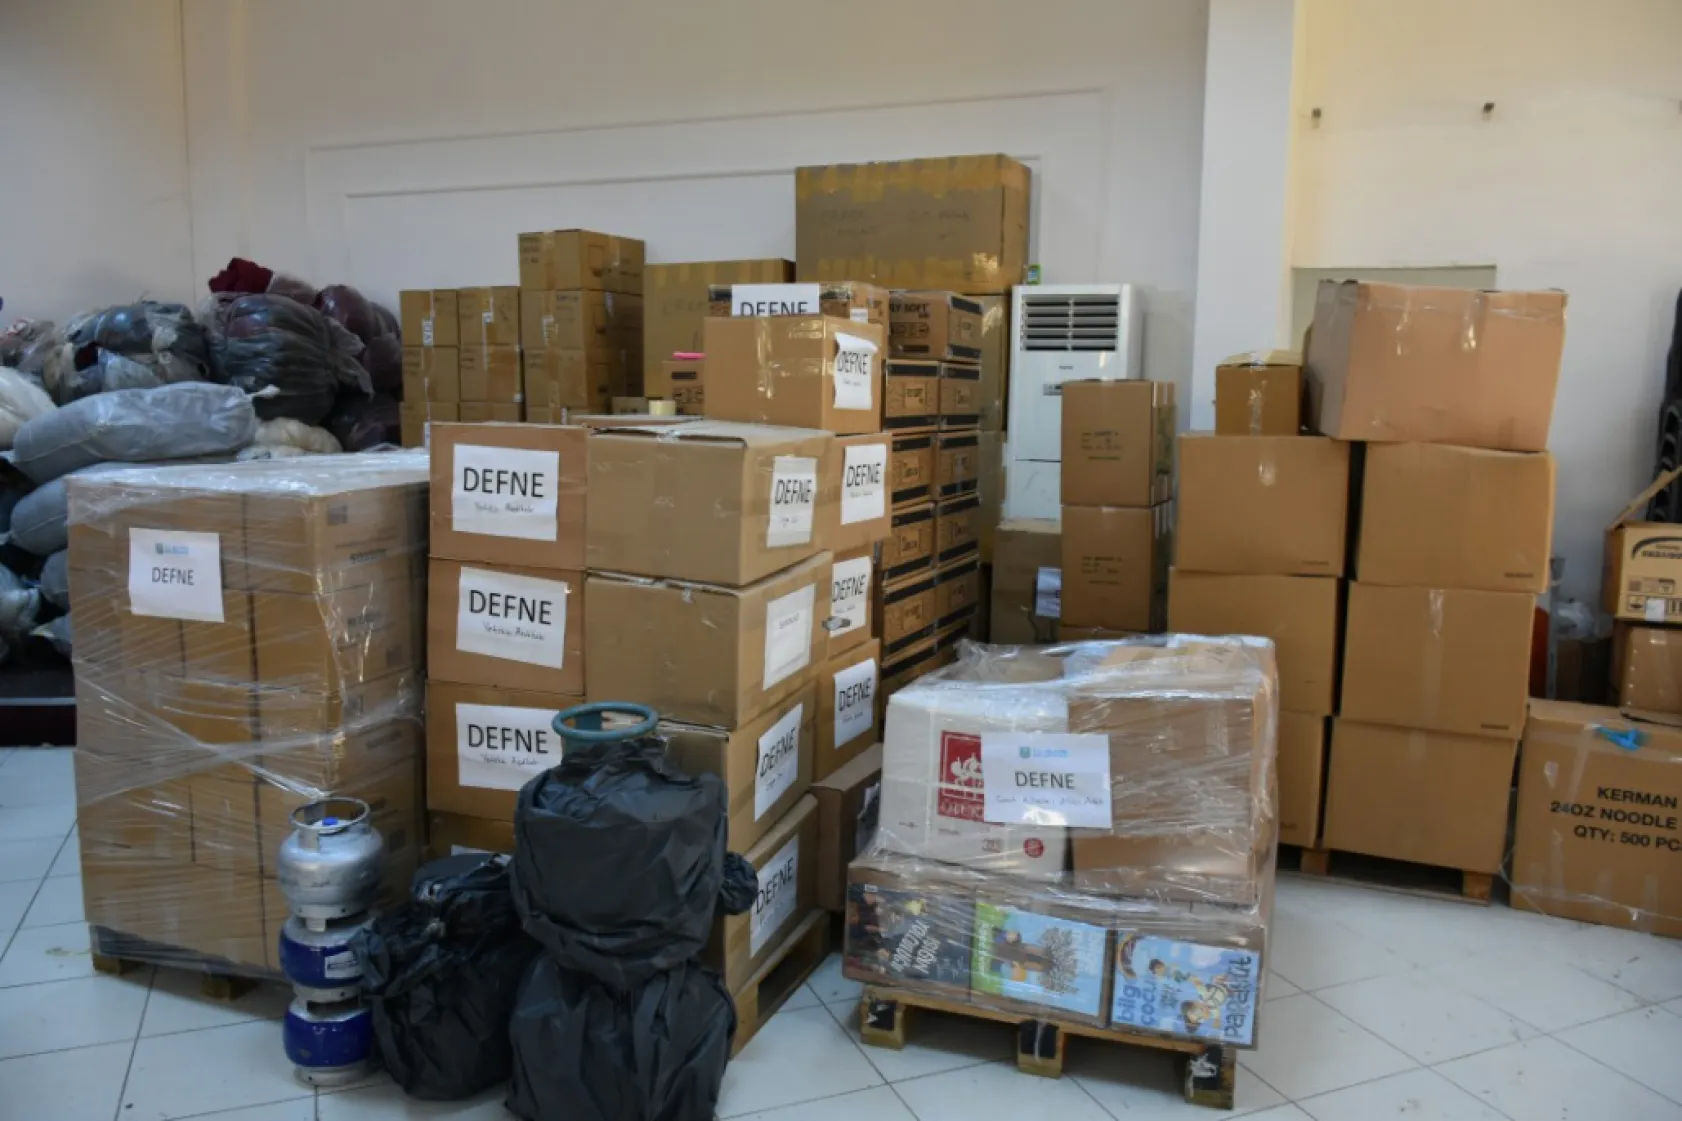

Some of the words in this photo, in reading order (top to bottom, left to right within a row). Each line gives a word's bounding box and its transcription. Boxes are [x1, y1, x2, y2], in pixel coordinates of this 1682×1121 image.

[837, 351, 868, 375] DEFNE
[463, 466, 545, 498] DEFNE
[846, 462, 881, 487] DEFNE
[775, 479, 812, 505] DEFNE
[151, 566, 194, 586] DEFNE
[832, 574, 866, 602] DEFNE
[469, 589, 552, 625] DEFNE
[838, 676, 871, 711] DEFNE
[468, 723, 549, 754] DEFNE
[760, 726, 796, 778] DEFNE
[1014, 770, 1076, 789] DEFNE
[1597, 786, 1678, 809] KERMAN
[1600, 807, 1678, 830] NOODLE
[1573, 825, 1615, 843] QTY:
[1620, 831, 1651, 848] 500
[1655, 836, 1682, 852] PC
[756, 857, 793, 915] DEFNE
